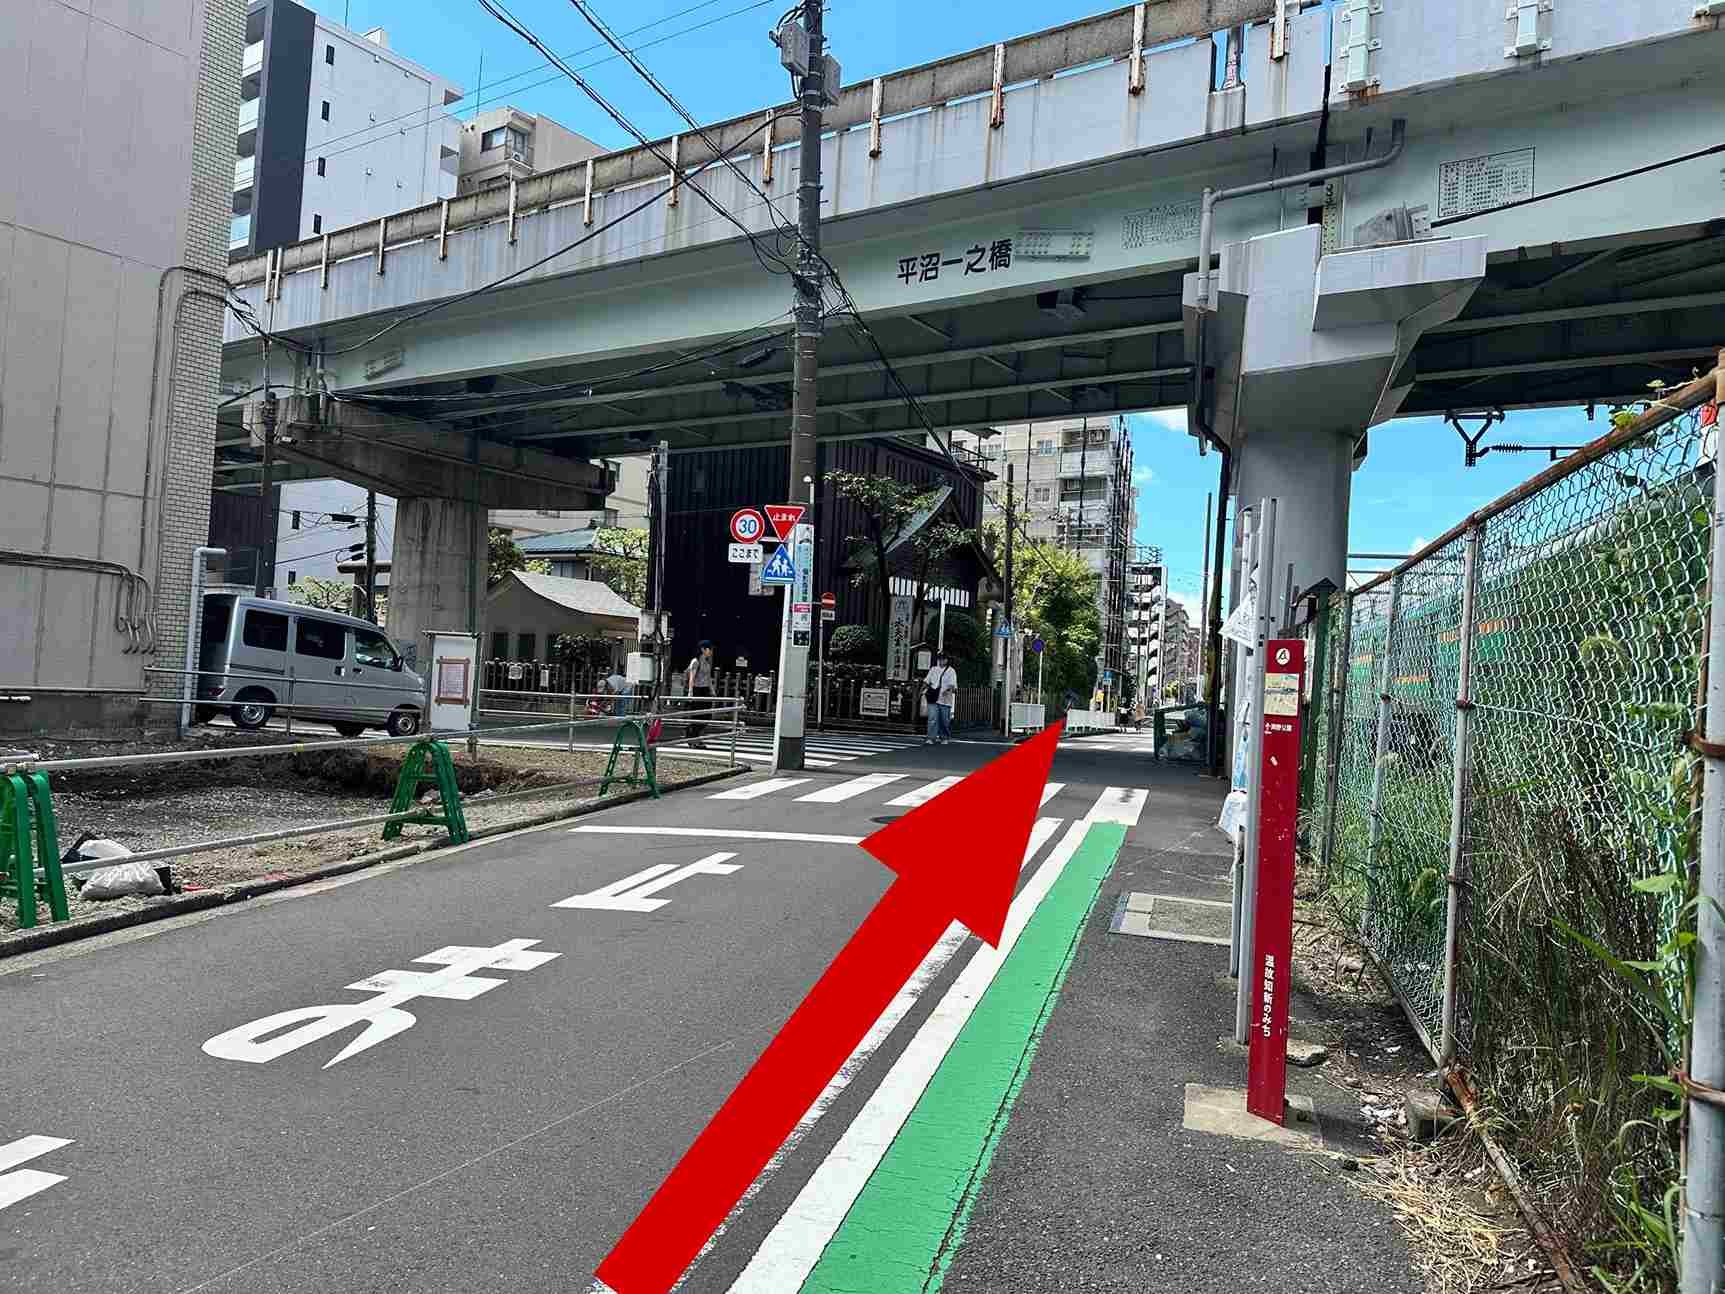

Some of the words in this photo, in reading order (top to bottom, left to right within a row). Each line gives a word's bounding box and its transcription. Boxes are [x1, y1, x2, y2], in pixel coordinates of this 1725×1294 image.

[896, 238, 1013, 285] 平沼一之橋
[772, 513, 796, 522] 止まれ
[738, 519, 757, 534] 30
[731, 547, 760, 559] ここまで
[1262, 954, 1275, 1037] 温故知新のみち
